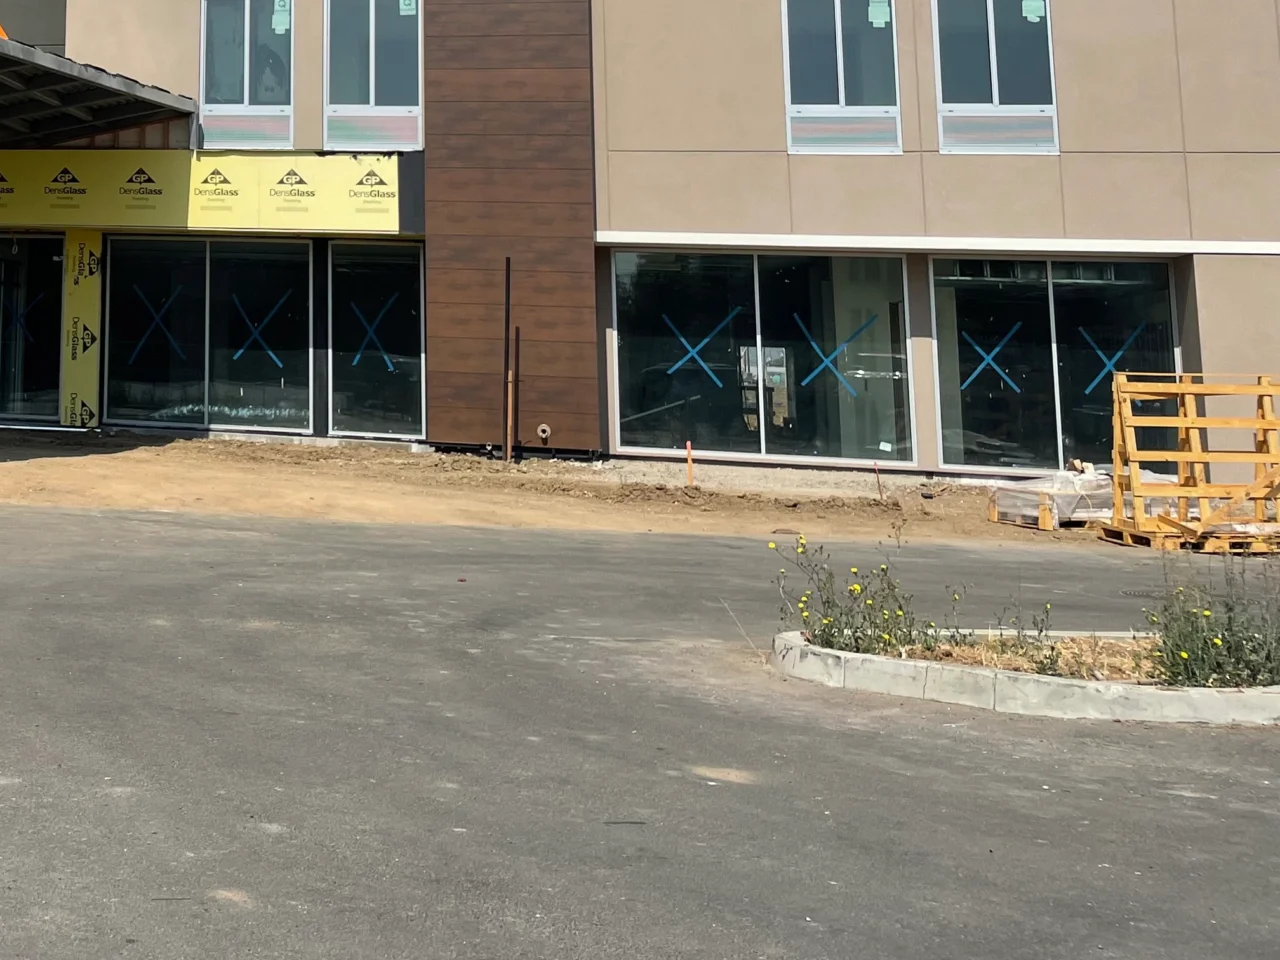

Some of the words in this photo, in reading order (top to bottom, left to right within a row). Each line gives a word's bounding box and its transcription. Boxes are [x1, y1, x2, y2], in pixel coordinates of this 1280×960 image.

[57, 173, 73, 182] GP
[132, 173, 149, 182] GP
[207, 174, 224, 183] GP
[282, 174, 300, 183] GP
[362, 175, 380, 184] GP
[44, 186, 86, 195] DensGlass
[119, 186, 162, 195] DensGlass
[194, 187, 239, 197] DensGlass
[269, 188, 315, 197] DensGlass
[349, 189, 396, 199] DensGlass
[89, 255, 98, 272] GP
[71, 316, 80, 361] DensGlass
[83, 330, 92, 347] GP
[81, 406, 90, 424] GP
